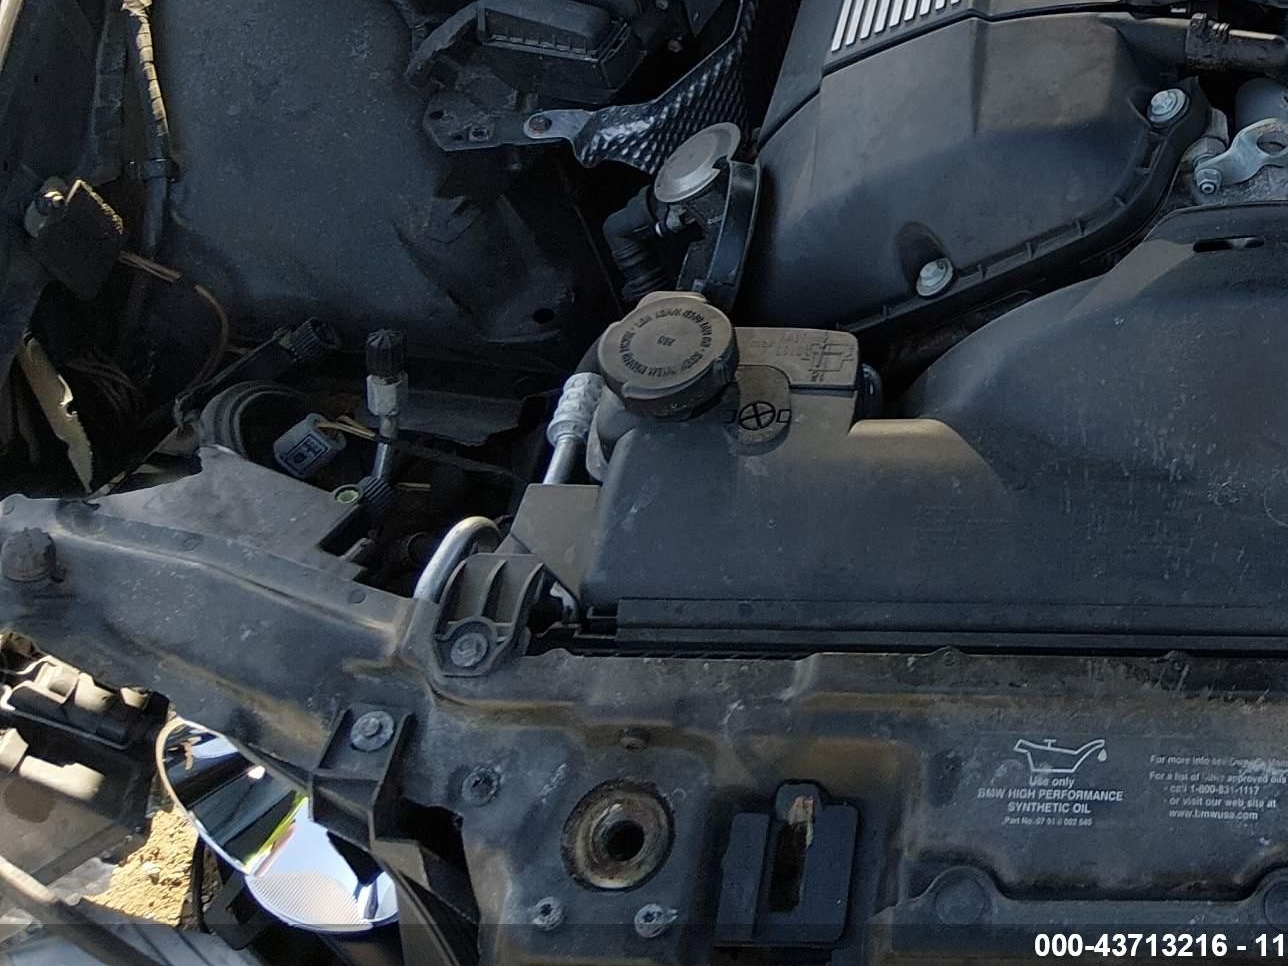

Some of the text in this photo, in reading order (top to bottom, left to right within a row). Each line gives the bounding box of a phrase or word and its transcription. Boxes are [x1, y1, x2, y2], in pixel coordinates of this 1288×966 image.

[1150, 756, 1166, 764] For
[1192, 756, 1209, 765] info
[1029, 776, 1075, 789] Use only
[1149, 771, 1164, 780] For
[1190, 772, 1200, 781] of
[1227, 774, 1268, 785] approved
[977, 788, 1124, 802] BMW HIGH PERFORMANCE
[1008, 802, 1092, 814] SYNTHETIC OIL
[1169, 797, 1180, 805] or
[1183, 797, 1202, 806] visit
[1205, 798, 1221, 806] our
[1225, 798, 1243, 807] web
[1266, 800, 1276, 808] at
